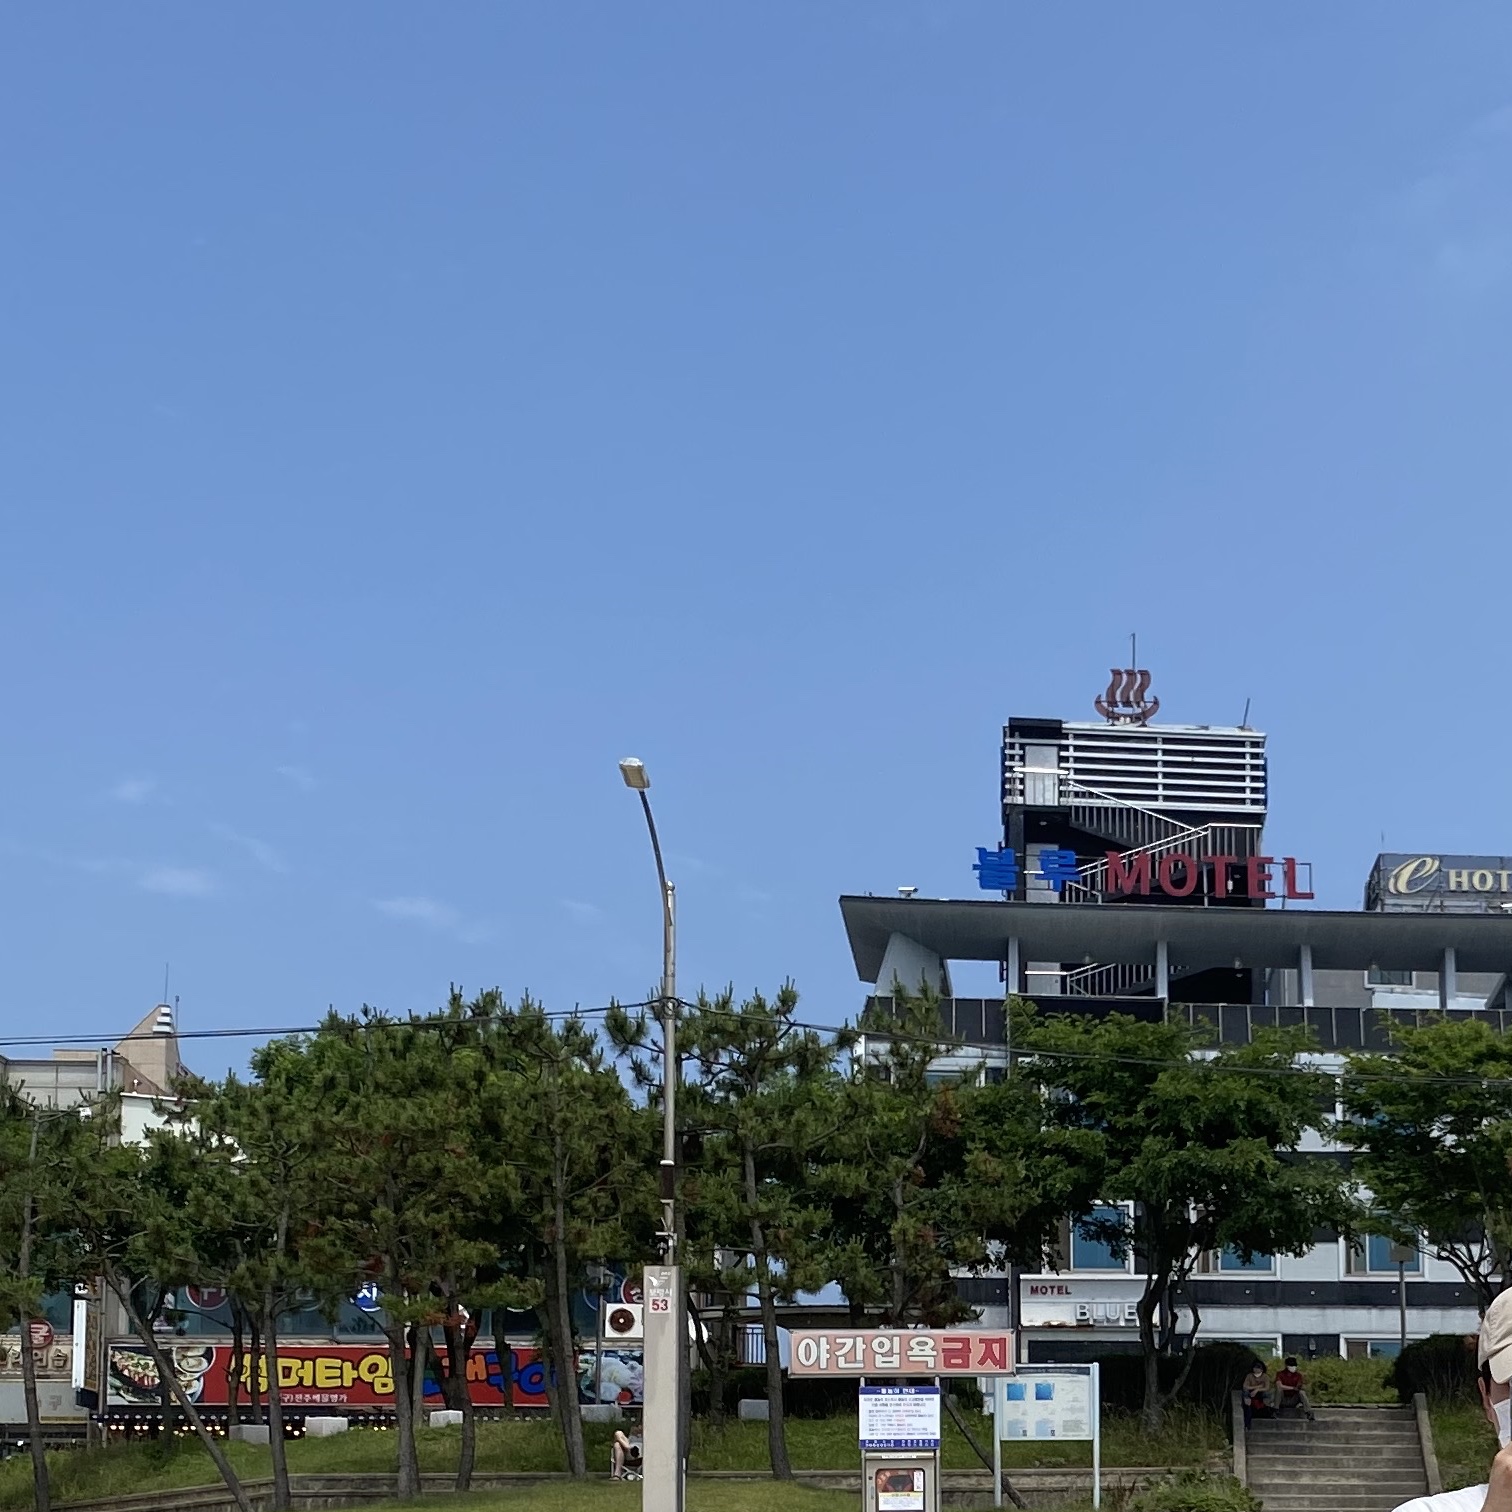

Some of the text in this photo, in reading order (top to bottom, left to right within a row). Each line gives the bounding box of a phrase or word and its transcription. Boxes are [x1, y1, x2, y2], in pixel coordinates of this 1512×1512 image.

[1105, 851, 1314, 900] MOTEL
[1030, 1286, 1072, 1295] MOTEL
[652, 1299, 669, 1311] 53
[1076, 1303, 1137, 1321] BLUE
[797, 1337, 1007, 1369] 야간입욕금지
